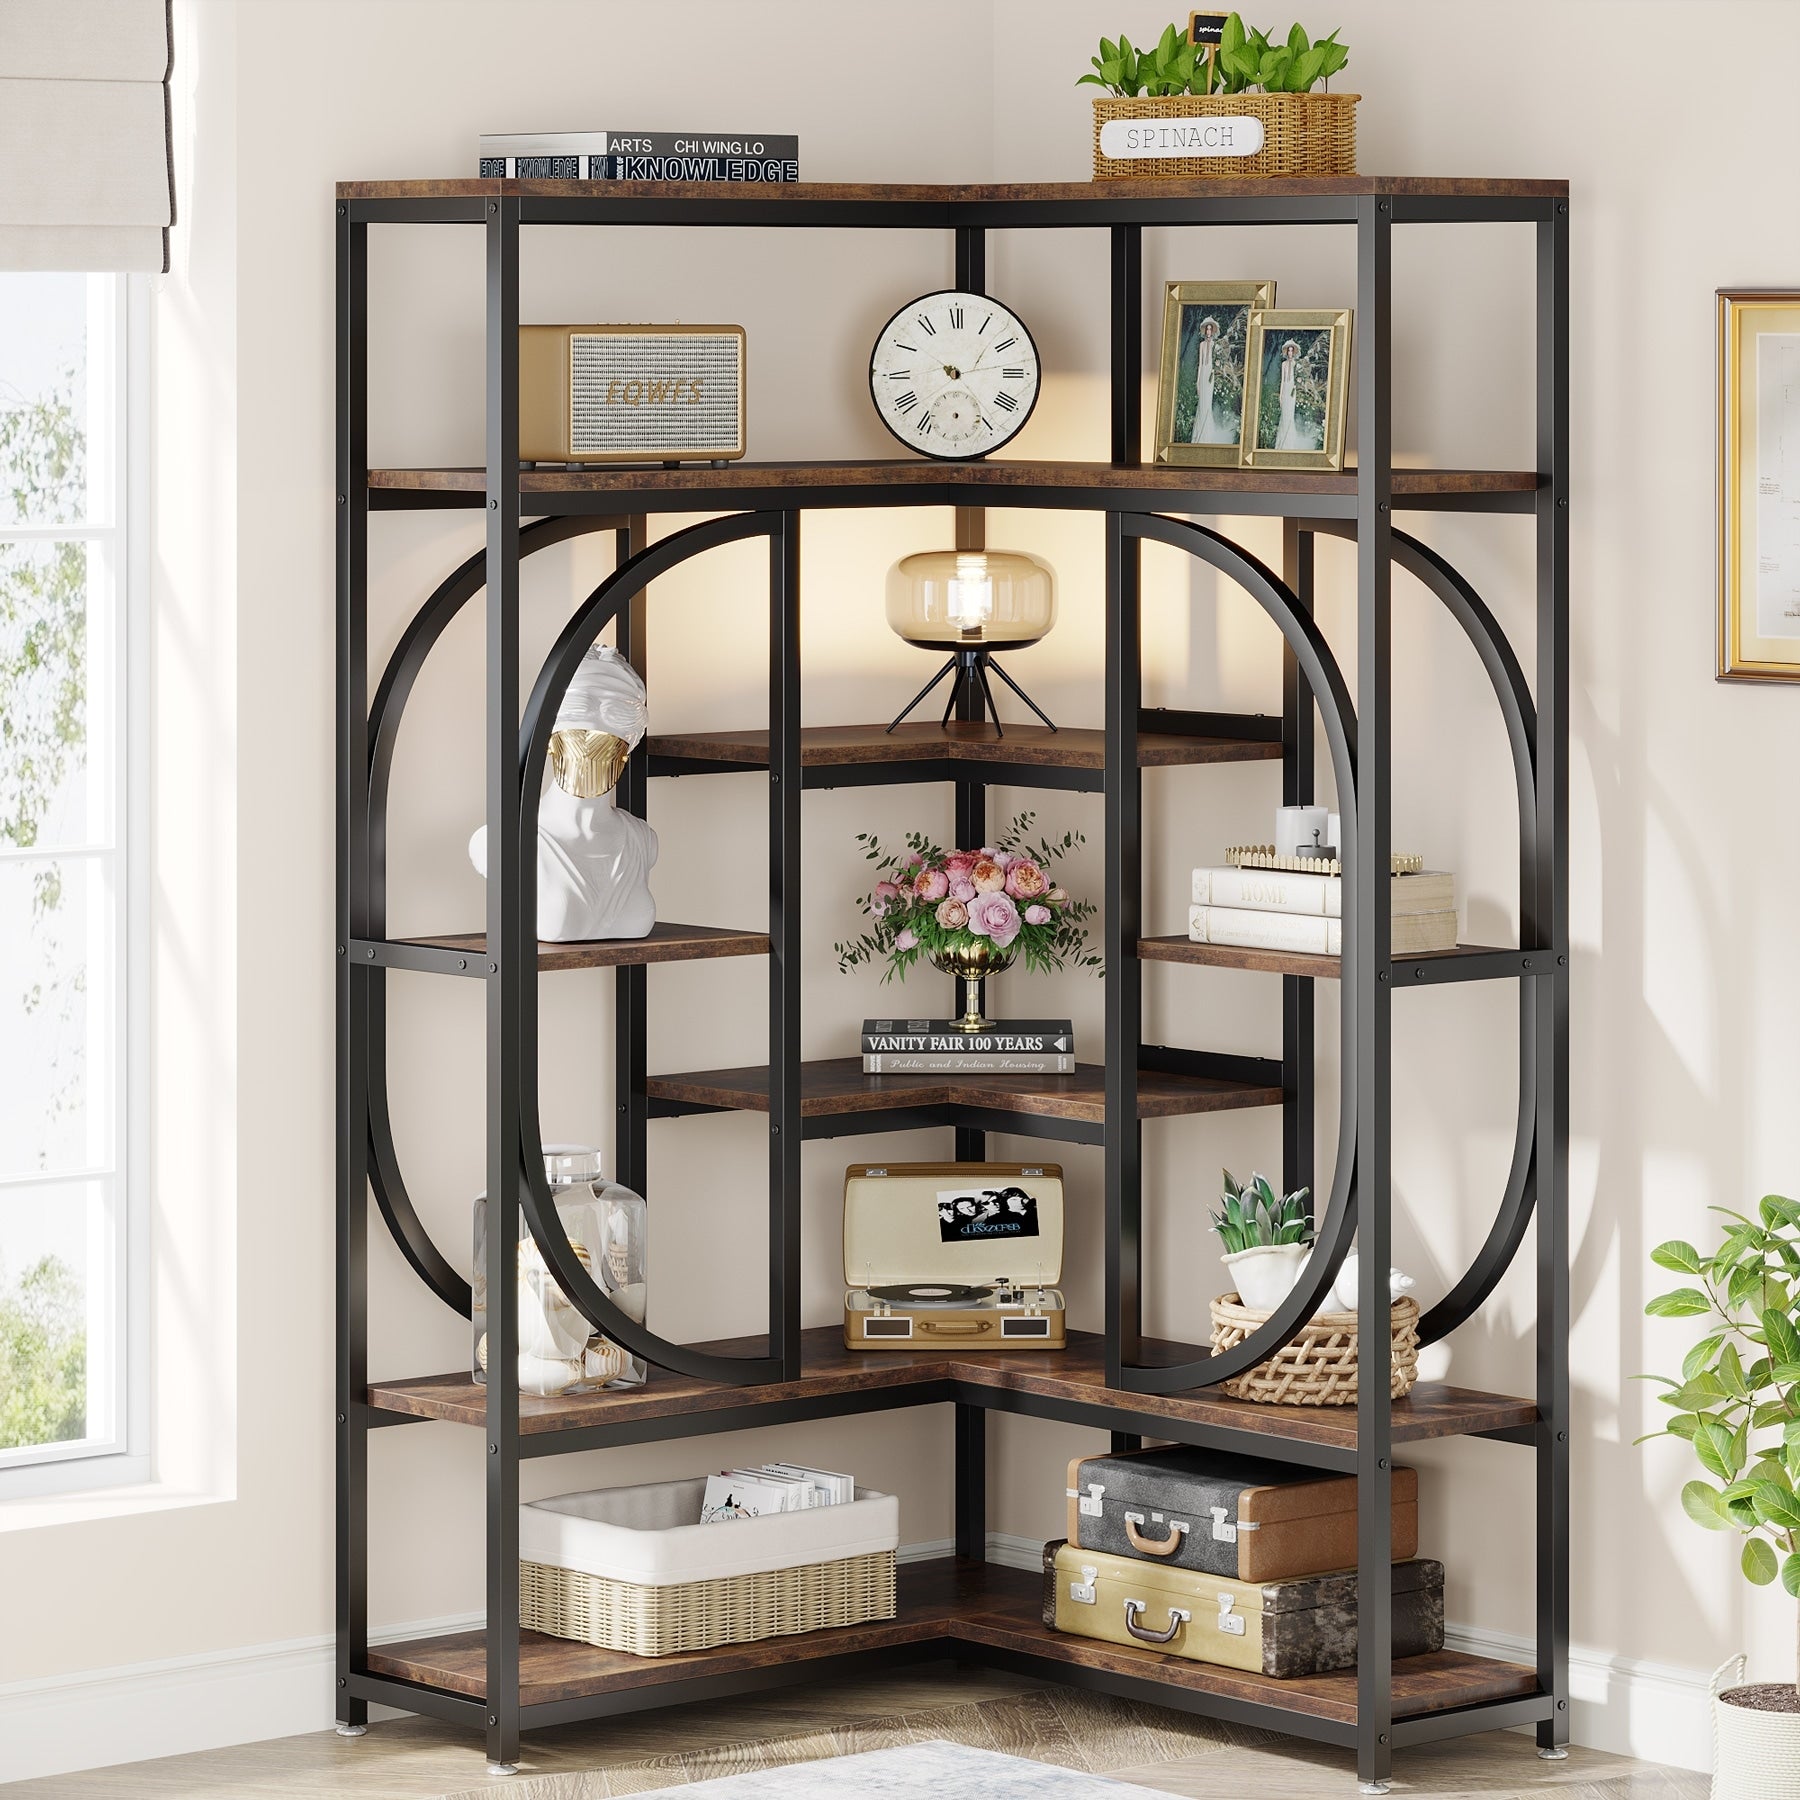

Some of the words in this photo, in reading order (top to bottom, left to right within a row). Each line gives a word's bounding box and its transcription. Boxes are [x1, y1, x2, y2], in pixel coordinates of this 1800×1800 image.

[610, 138, 653, 152] ARTS
[674, 139, 699, 154] CHI
[702, 140, 742, 155] WING
[745, 142, 764, 155] LO
[1126, 126, 1234, 149] SPINACH
[521, 157, 578, 180] KNOWLEDGE
[626, 156, 798, 182] KNOWLEDGE
[1240, 880, 1287, 904] HOME
[868, 1036, 926, 1051] VANITY
[930, 1036, 965, 1051] FAIR
[968, 1036, 992, 1051] 100
[994, 1036, 1043, 1051] YEARS
[889, 1058, 924, 1069] Public
[929, 1058, 951, 1069] and
[955, 1058, 994, 1069] Indian
[999, 1058, 1046, 1072] Housing
